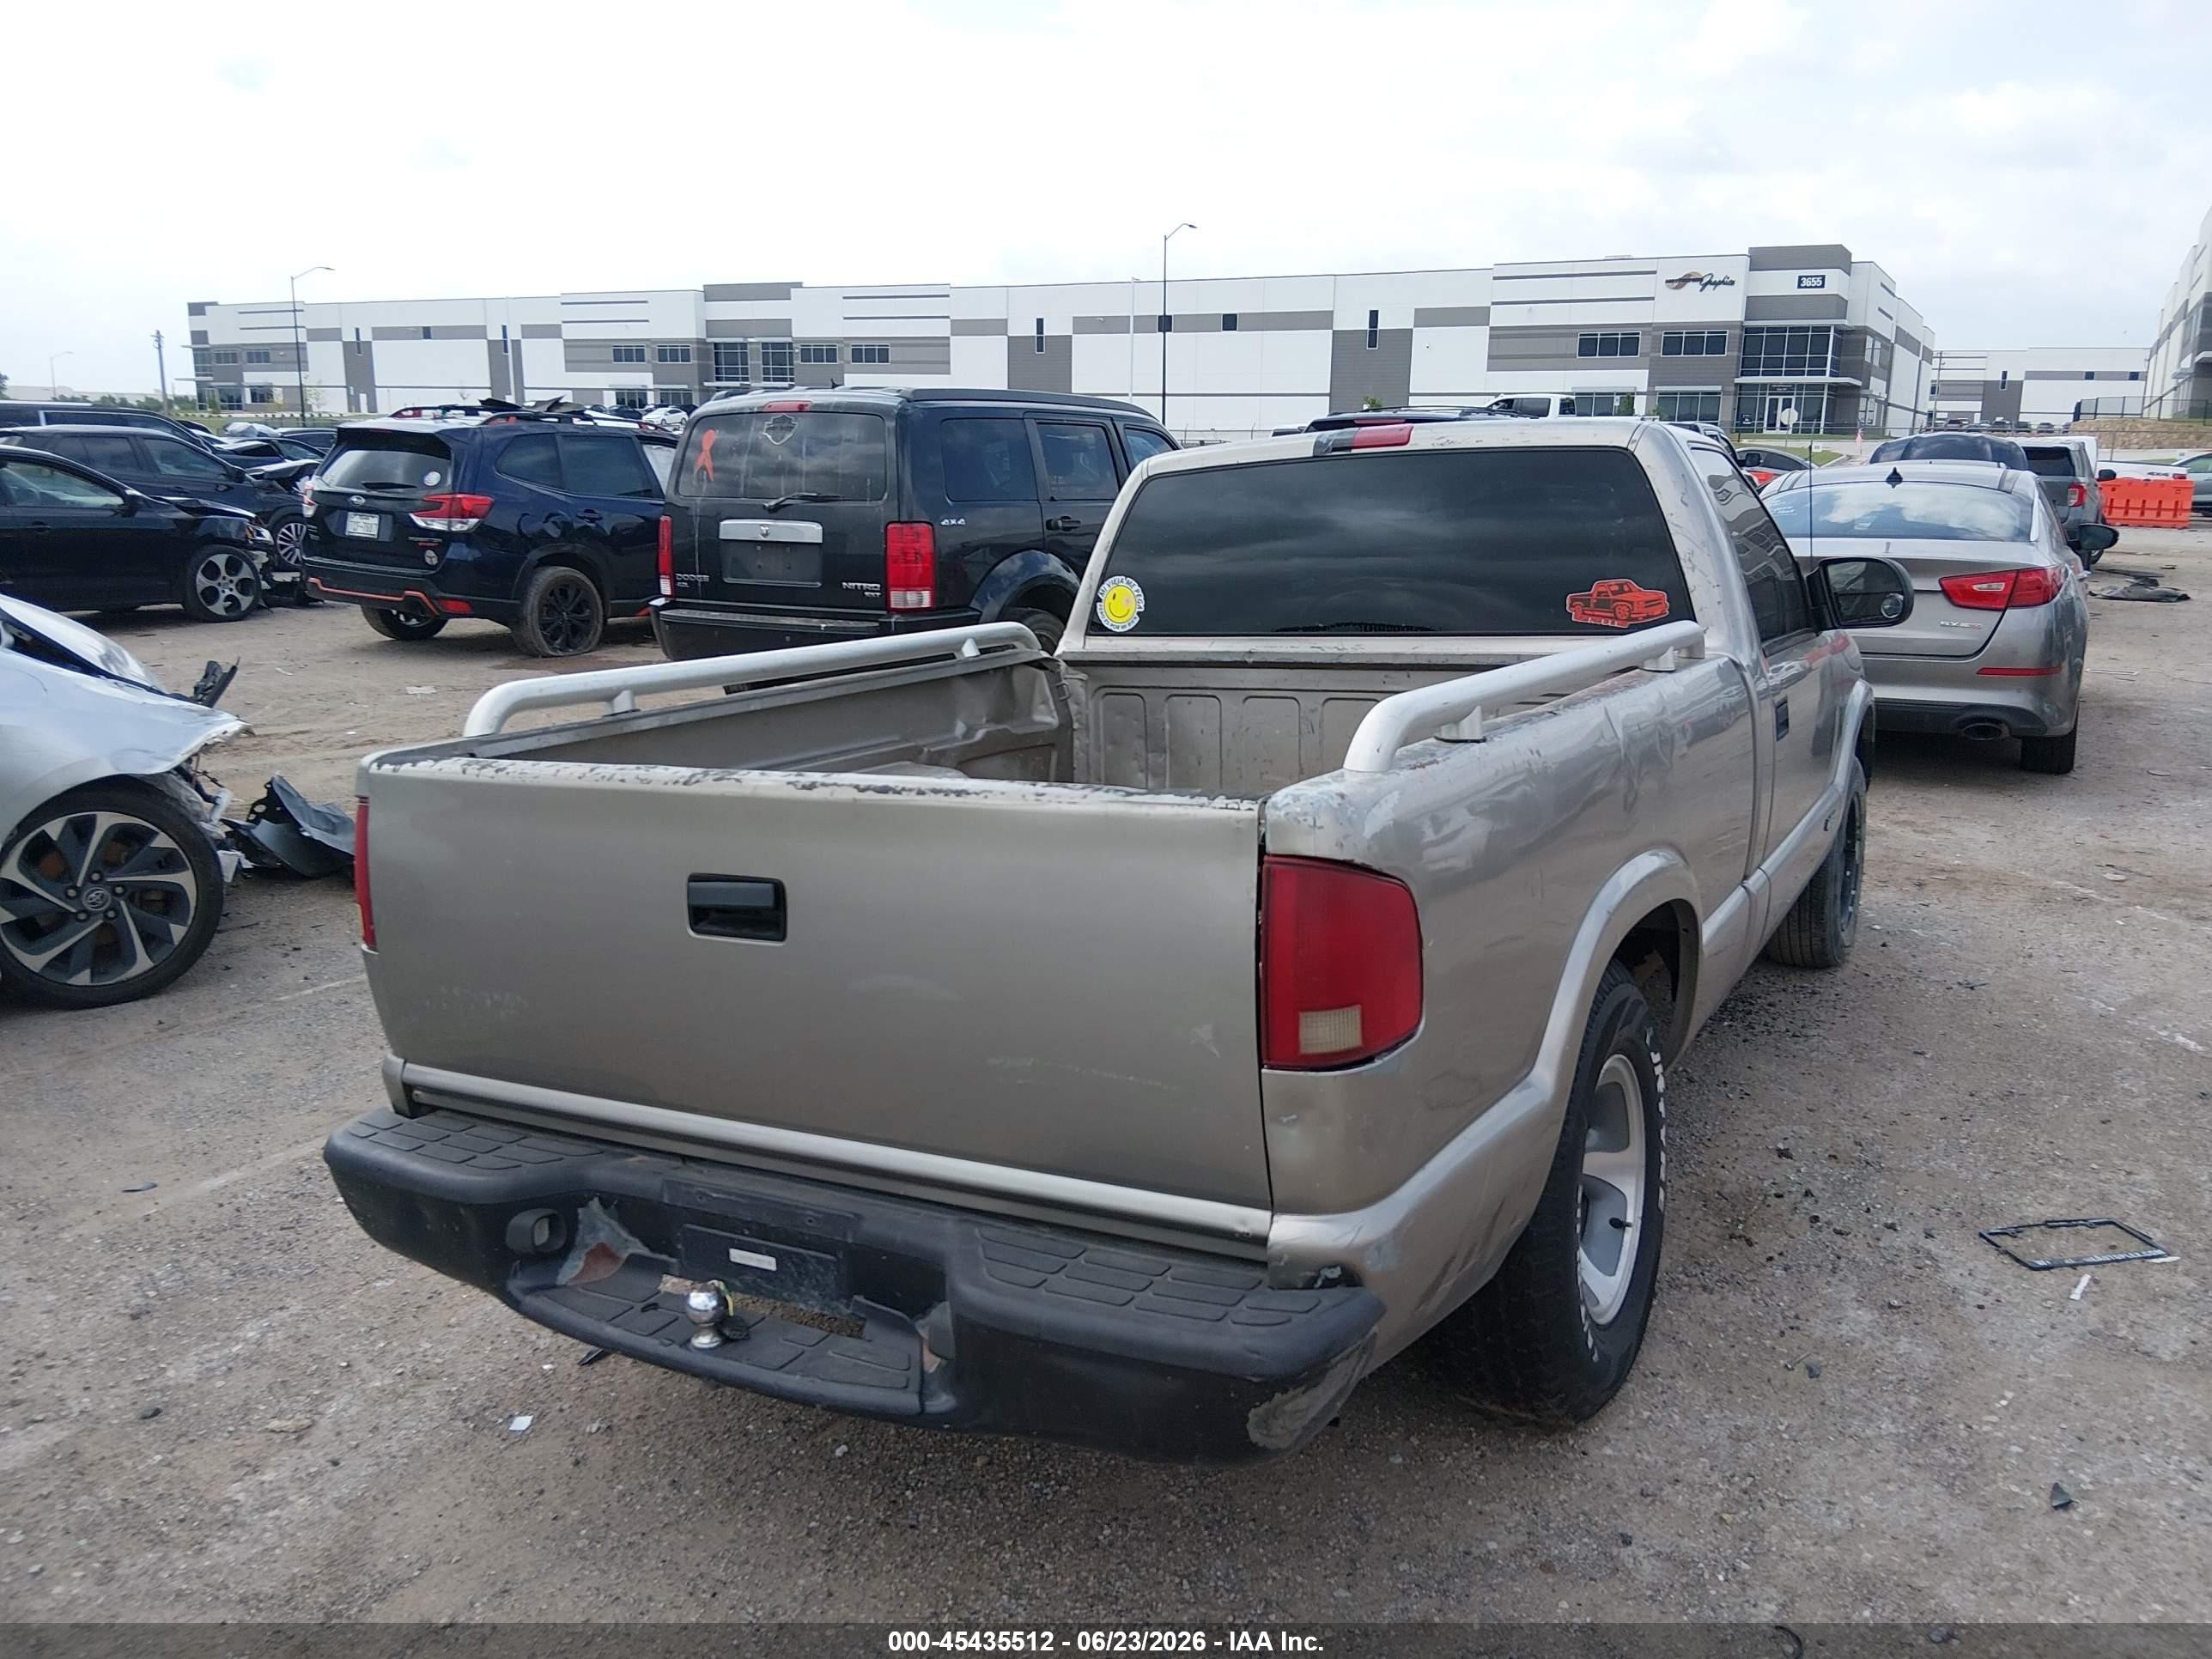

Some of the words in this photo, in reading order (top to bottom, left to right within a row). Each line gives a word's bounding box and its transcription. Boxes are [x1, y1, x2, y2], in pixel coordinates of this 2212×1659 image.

[1800, 276, 1823, 287] 3655
[675, 573, 710, 582] DODGE
[842, 581, 881, 591] NITRO
[1134, 588, 1144, 611] PEGA
